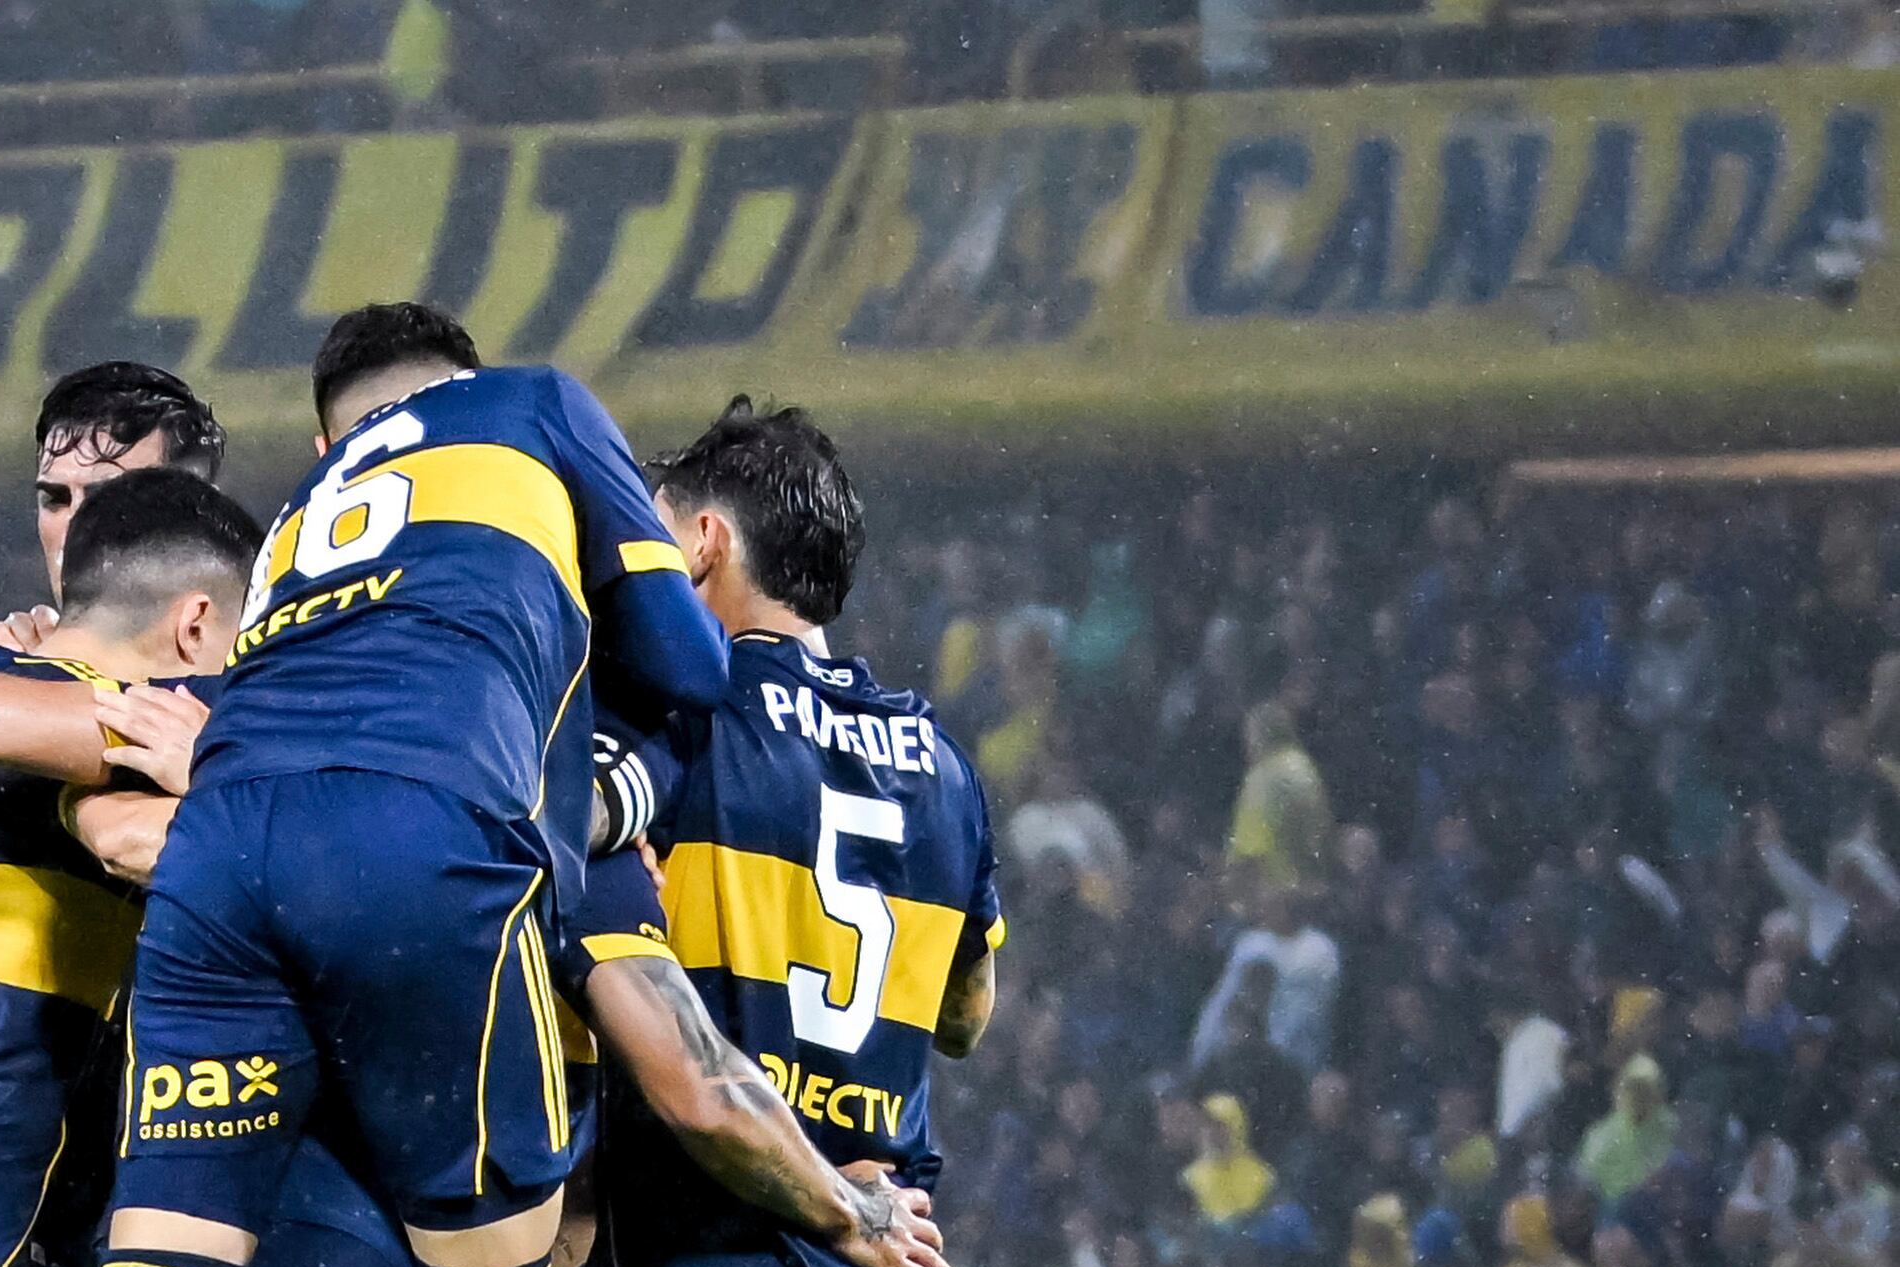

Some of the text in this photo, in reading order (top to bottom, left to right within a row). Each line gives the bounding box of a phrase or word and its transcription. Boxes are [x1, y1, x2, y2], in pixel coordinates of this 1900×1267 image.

[245, 411, 424, 620] 6
[787, 782, 903, 1056] 5
[139, 1110, 280, 1140] assistance
[759, 1052, 903, 1138] DIECTV
